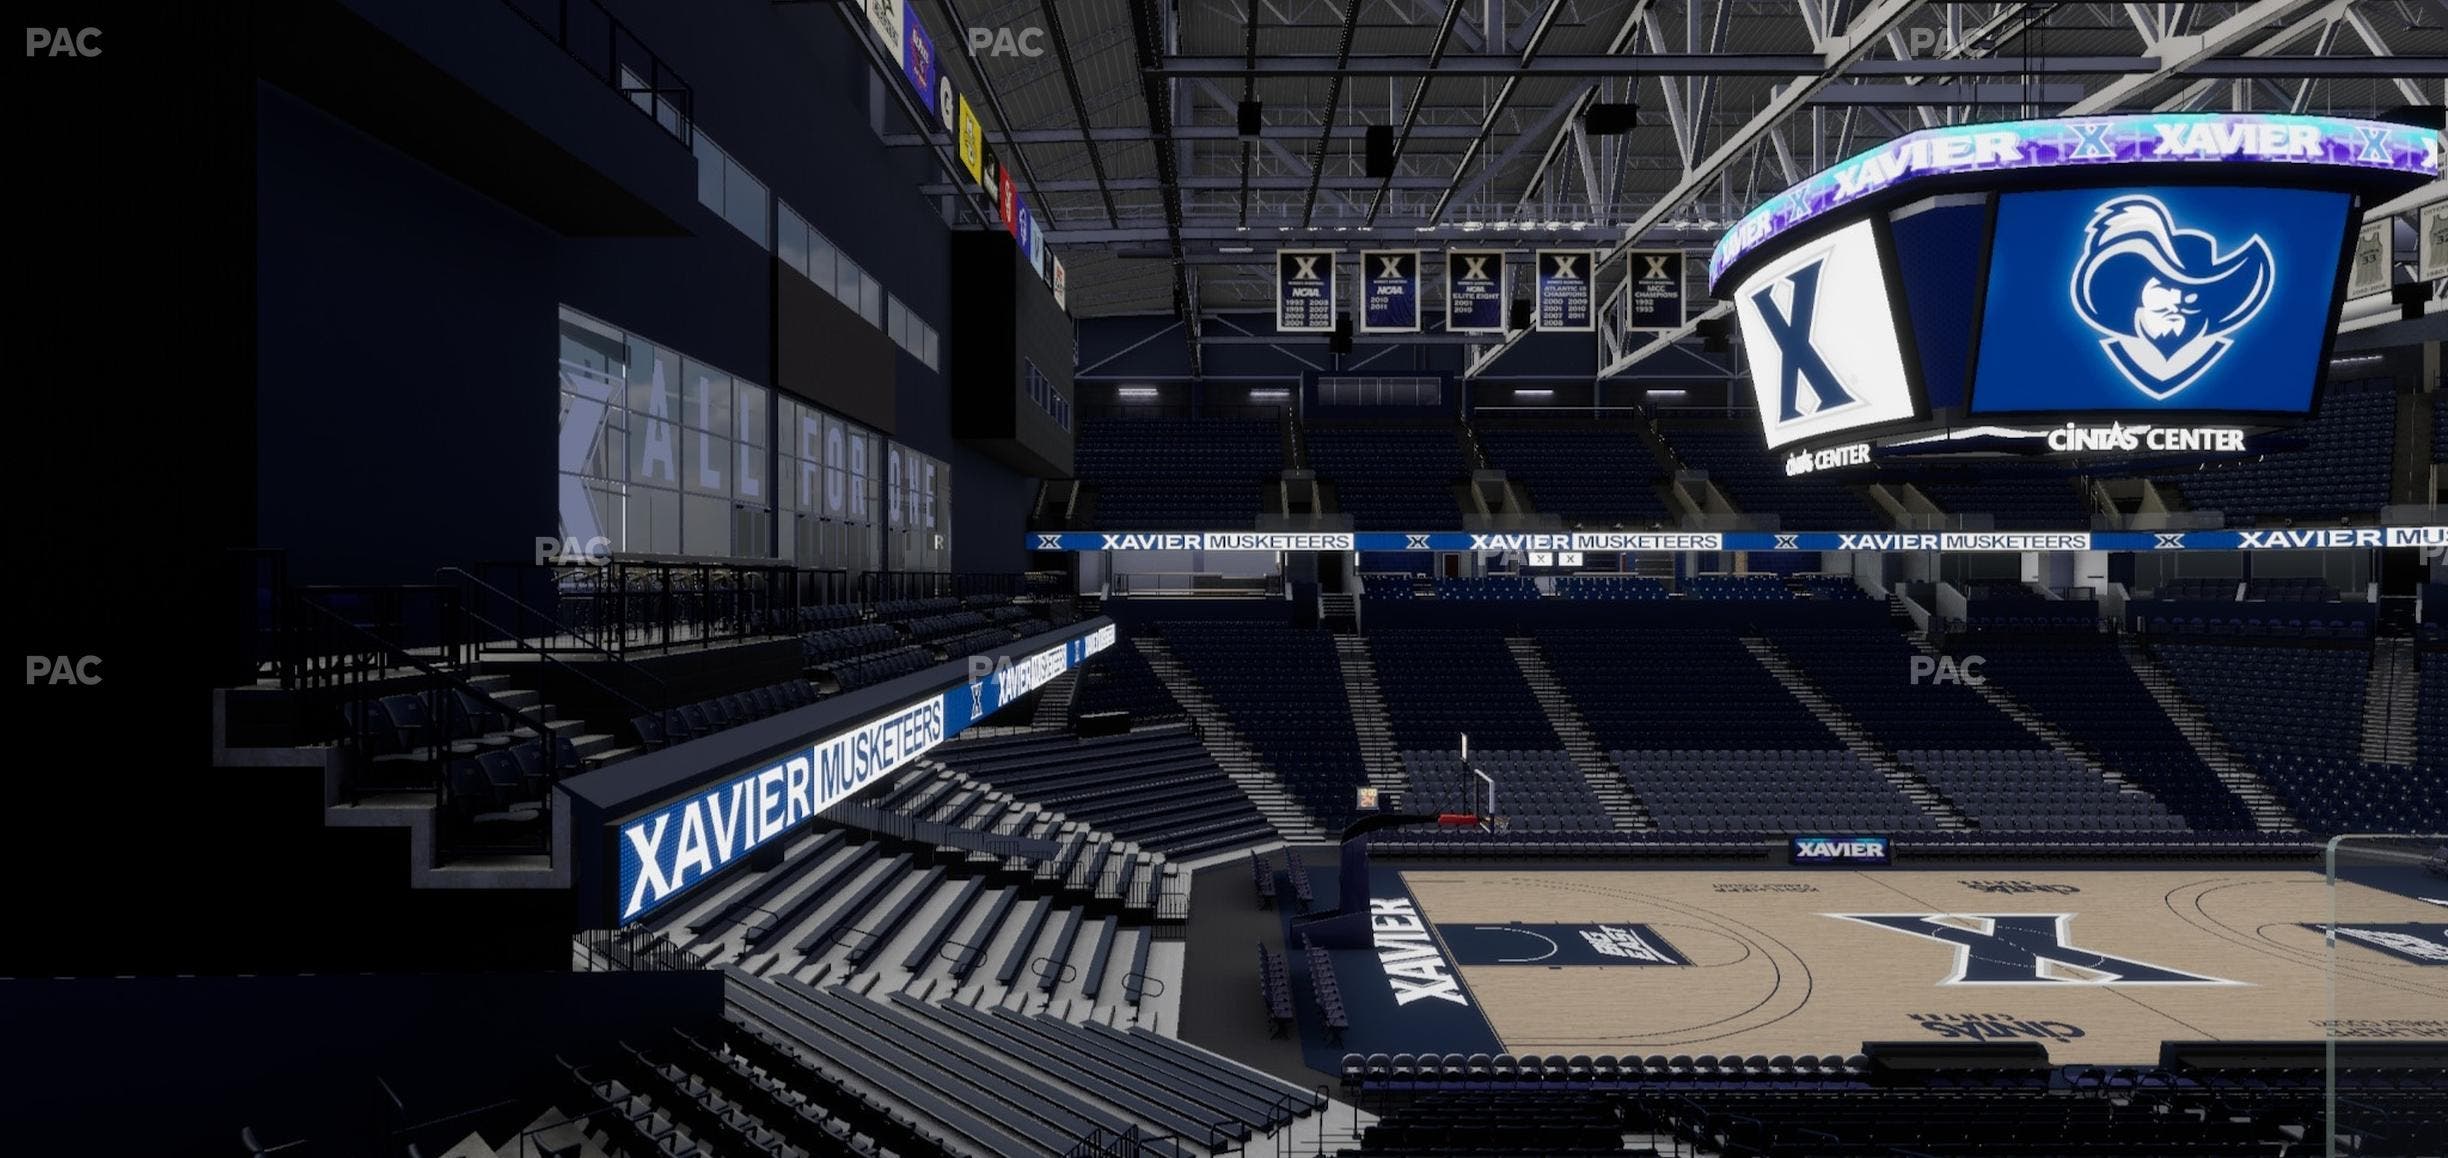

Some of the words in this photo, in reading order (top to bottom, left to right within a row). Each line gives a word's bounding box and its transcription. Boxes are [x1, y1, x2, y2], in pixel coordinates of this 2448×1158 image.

[1833, 131, 2025, 200] XAVIER
[2068, 123, 2117, 159] X
[2154, 123, 2323, 156] XAVIER
[2355, 127, 2394, 163] X
[1292, 288, 1321, 297] NCAA
[1377, 286, 1403, 295] NCAA
[1749, 250, 1862, 426] X
[641, 359, 760, 497] ALL
[803, 416, 866, 517] FOR
[889, 448, 935, 529] ONE
[2146, 427, 2246, 451] CENTER
[1815, 444, 1871, 470] CENTER
[1102, 534, 1201, 550] XAVIER
[1210, 535, 1349, 549] MUSKETEERS
[1470, 534, 1570, 550] XAVIER
[1578, 535, 1718, 549] MUSKETEERS
[1837, 534, 1940, 550] XAVIER
[1947, 535, 2086, 549] MUSKETEERS
[2237, 529, 2383, 547] XAVIER
[2396, 528, 2448, 545] MU
[623, 756, 812, 919] XAVIER
[820, 701, 941, 804] MUSKETEERS
[998, 661, 1031, 707] XAVIER
[1796, 842, 1885, 858] XAVIER
[1370, 898, 1468, 1006] XAVIER
